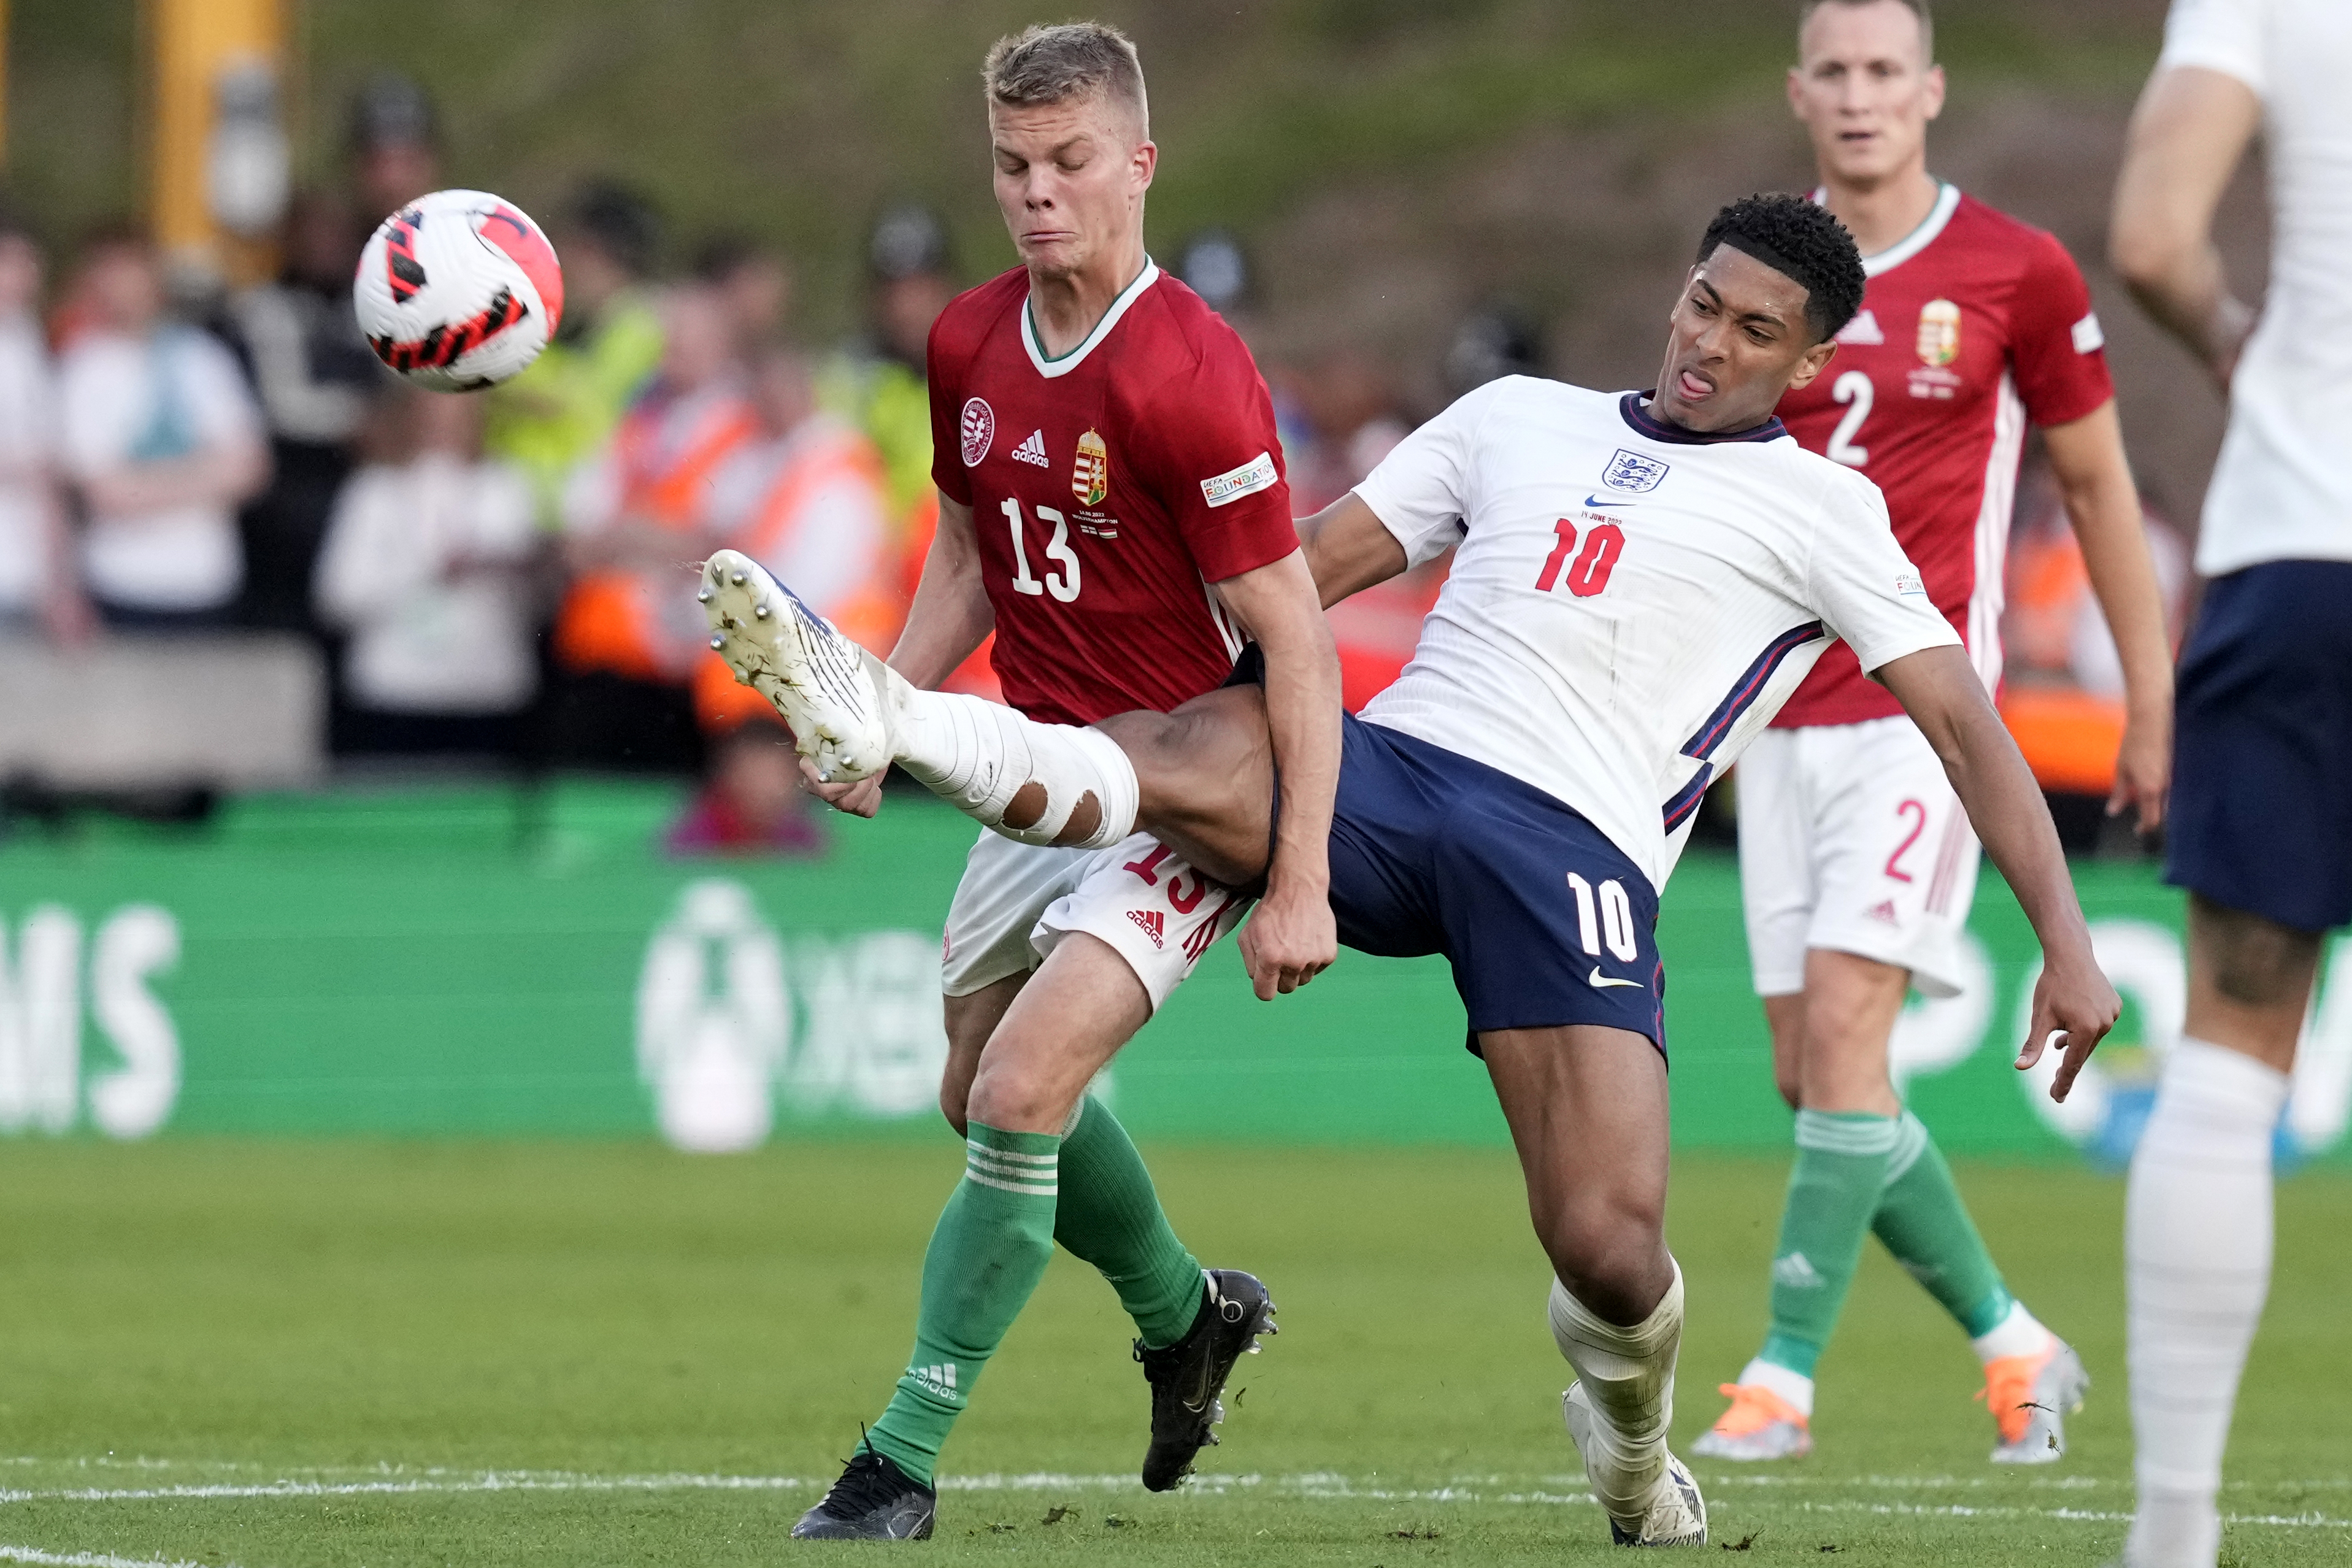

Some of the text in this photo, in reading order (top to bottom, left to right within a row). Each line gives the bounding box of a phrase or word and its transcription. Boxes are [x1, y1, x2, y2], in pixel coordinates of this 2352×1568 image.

[1826, 370, 1874, 465] 2
[1011, 449, 1049, 468] adidas
[1204, 478, 1223, 488] UEFA
[1205, 462, 1274, 498] FOUNDATION
[1589, 512, 1606, 523] JUNE
[1001, 498, 1081, 602] 13
[1535, 518, 1626, 598] 10
[1886, 799, 1926, 883] 2
[1126, 910, 1164, 950] adidas
[1567, 872, 1638, 963] 10
[909, 1369, 958, 1401] adidas
